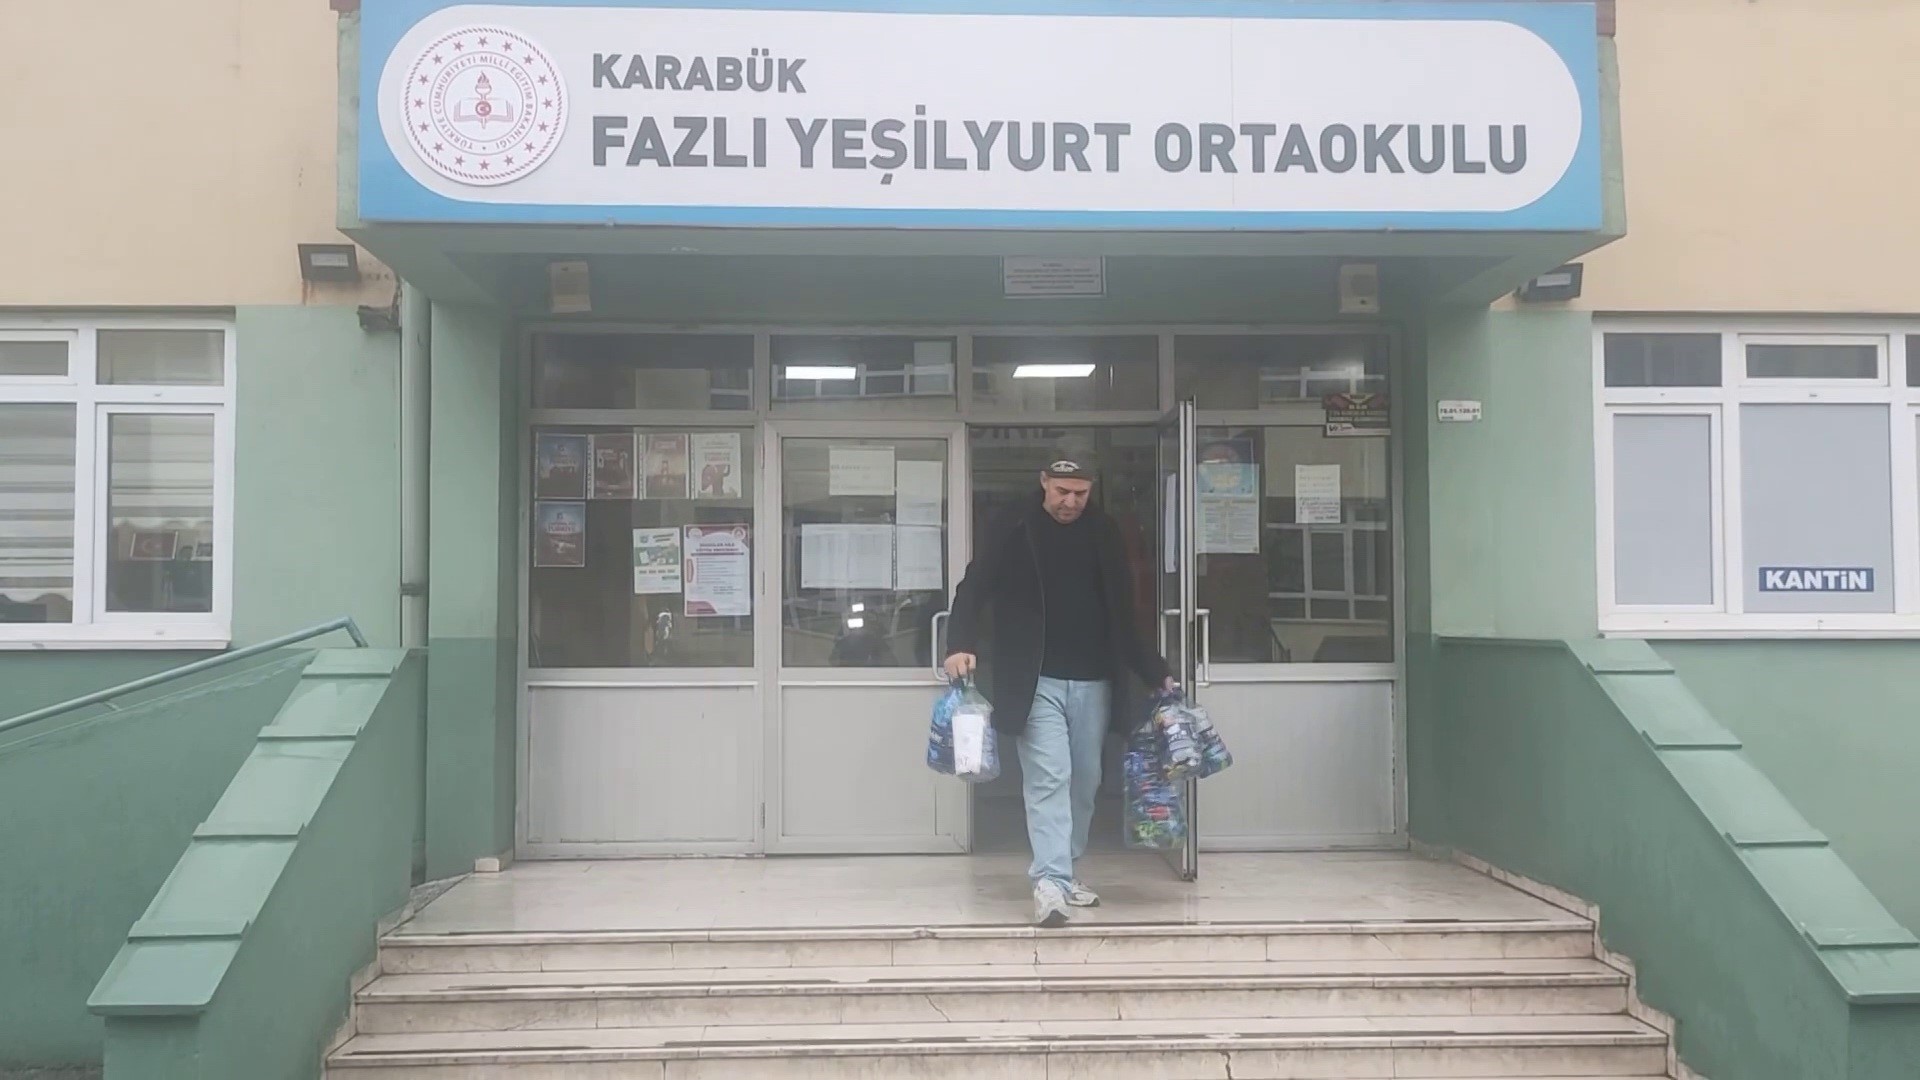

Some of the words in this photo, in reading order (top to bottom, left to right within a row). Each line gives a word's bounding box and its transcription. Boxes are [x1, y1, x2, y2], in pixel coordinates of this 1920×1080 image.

[480, 55, 510, 69] MİLLİ
[510, 66, 533, 100] EĞİTİM
[593, 48, 807, 93] KARABÜK
[434, 56, 477, 114] CUMHURİYETİ
[438, 116, 473, 149] TÜRKİYE
[496, 102, 534, 149] BAKANLIĞI
[593, 116, 767, 168] FAZLI
[786, 104, 1131, 186] YEŞİLYURT
[1154, 122, 1528, 174] ORTAOKULU
